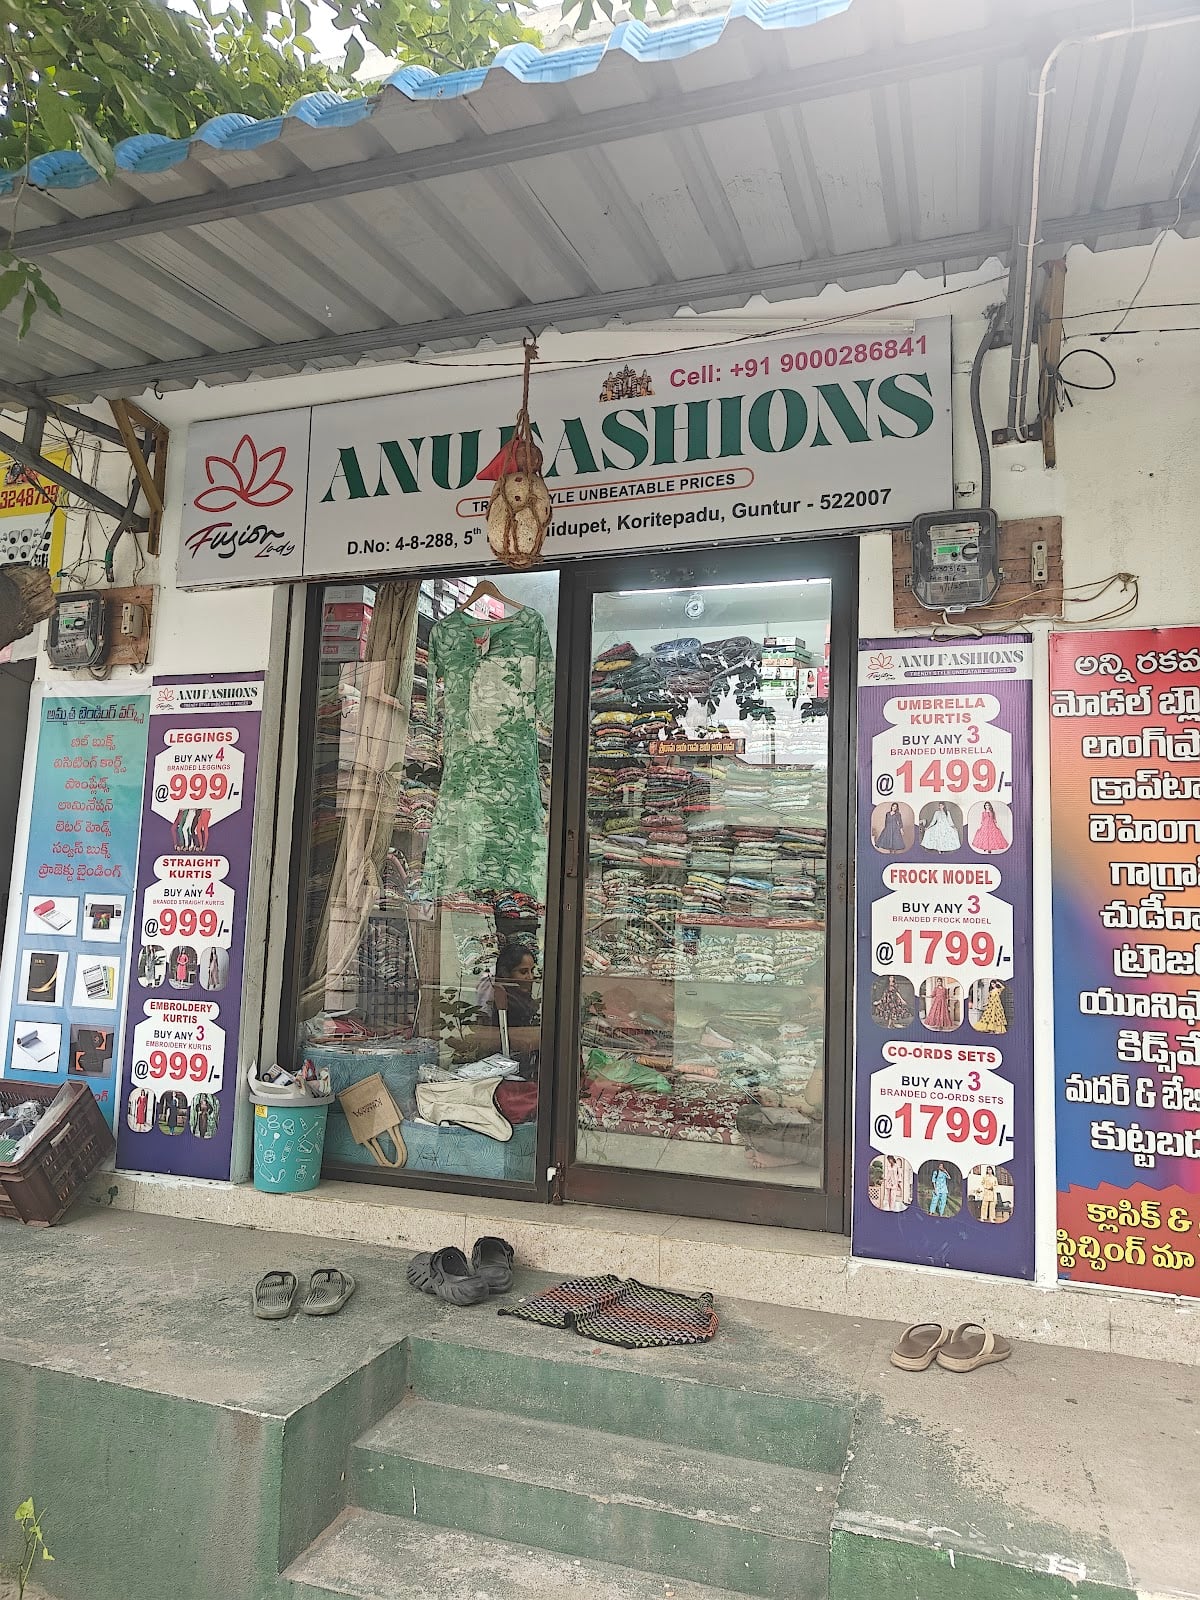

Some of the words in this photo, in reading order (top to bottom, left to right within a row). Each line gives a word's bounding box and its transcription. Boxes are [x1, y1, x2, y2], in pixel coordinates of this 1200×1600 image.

[669, 364, 722, 388] Cell:
[729, 355, 770, 381] +91
[780, 335, 928, 374] 9000286841
[320, 428, 482, 503] ANU
[549, 491, 574, 504] YLE
[578, 479, 676, 502] UNBEATABLE
[680, 472, 736, 490] PRICES
[347, 538, 391, 555] D.No:
[396, 532, 458, 551] 4-8-288,
[617, 506, 726, 532] Koritepadu,
[732, 498, 800, 519] Guntur
[820, 488, 892, 510] 522007
[254, 540, 296, 558] Lady
[898, 652, 936, 668] ANU
[938, 650, 1024, 667] FASHIONS
[1074, 652, 1136, 683] అన్ని
[176, 689, 201, 701] ANU
[202, 687, 258, 700] FASHIONS
[1051, 685, 1153, 718] మోడల్
[897, 697, 986, 711] UMBRELLA
[910, 712, 972, 725] KURTIS
[169, 731, 233, 744] LEGGINGS
[902, 735, 930, 746] BUY
[933, 734, 962, 745] ANY
[966, 725, 980, 744] 3
[174, 754, 193, 763] BUY
[194, 753, 213, 763] ANY
[215, 747, 225, 762] 4
[890, 747, 937, 756] BRANDED
[939, 746, 993, 755] UMBRELLA
[162, 858, 221, 868] STRAIGHT
[169, 868, 212, 879] KURTIS
[890, 869, 938, 884] FROCK
[943, 869, 993, 885] MODEL
[163, 888, 183, 898] BUY
[184, 887, 203, 898] ANY
[205, 882, 215, 898] 4
[902, 902, 930, 913] BUY
[933, 903, 963, 914] ANY
[967, 895, 981, 914] 3
[892, 915, 931, 923] BRANDED
[932, 916, 961, 924] FROCK
[962, 917, 991, 925] MODEL
[162, 1013, 198, 1024] KURTIS
[154, 1029, 173, 1039] BUY
[174, 1031, 193, 1041] ANY
[195, 1025, 205, 1041] 3
[145, 1040, 187, 1050] EMBROIDERY
[188, 1043, 212, 1051] KURTIS
[887, 1046, 953, 1060] CO-ORDS
[957, 1051, 996, 1063] SETS
[901, 1075, 930, 1088] BUY
[933, 1078, 963, 1090] ANY
[967, 1071, 982, 1091] 3
[880, 1088, 927, 1099] BRANDED
[930, 1091, 975, 1103] CO-ORDS
[978, 1096, 1004, 1105] SETS
[1065, 1073, 1130, 1106] మదర్
[1135, 1077, 1157, 1108] &
[1167, 1207, 1193, 1232] &
